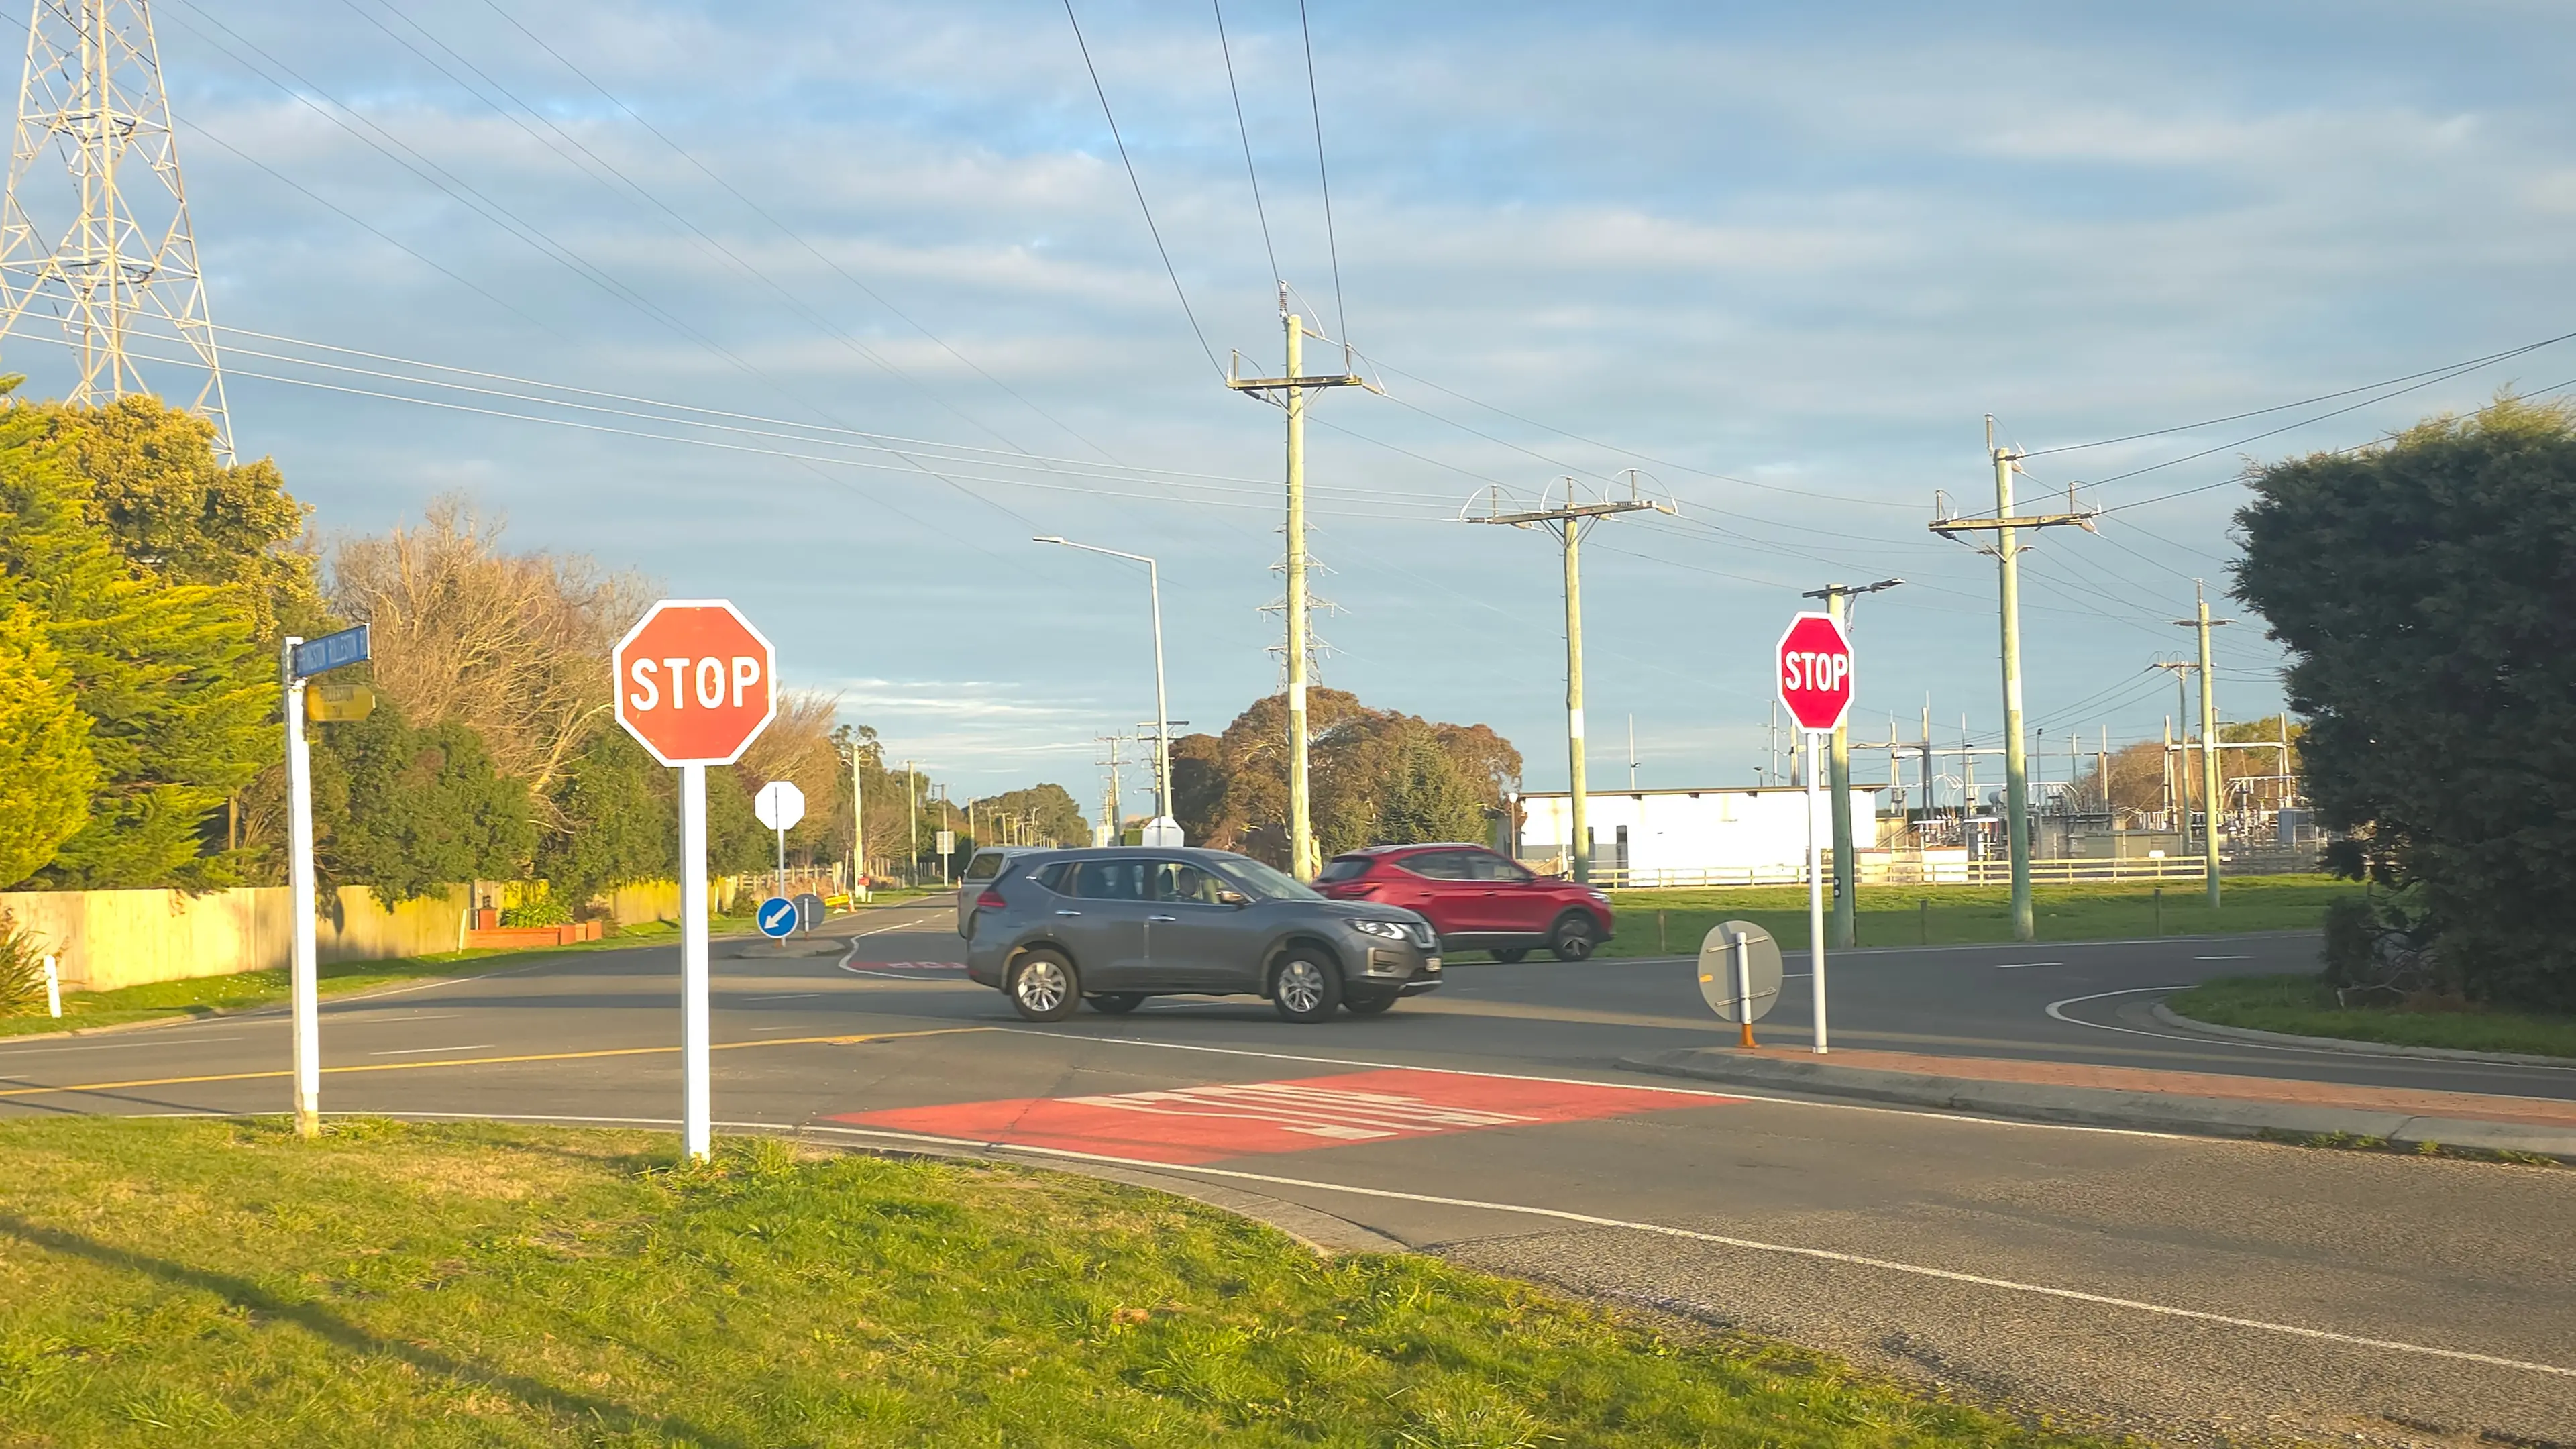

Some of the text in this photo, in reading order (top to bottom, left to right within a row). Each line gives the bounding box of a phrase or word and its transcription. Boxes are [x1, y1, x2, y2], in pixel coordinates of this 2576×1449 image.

[630, 656, 761, 711] STOP
[1785, 651, 1848, 692] STOP
[1053, 1083, 1541, 1140] STOP
